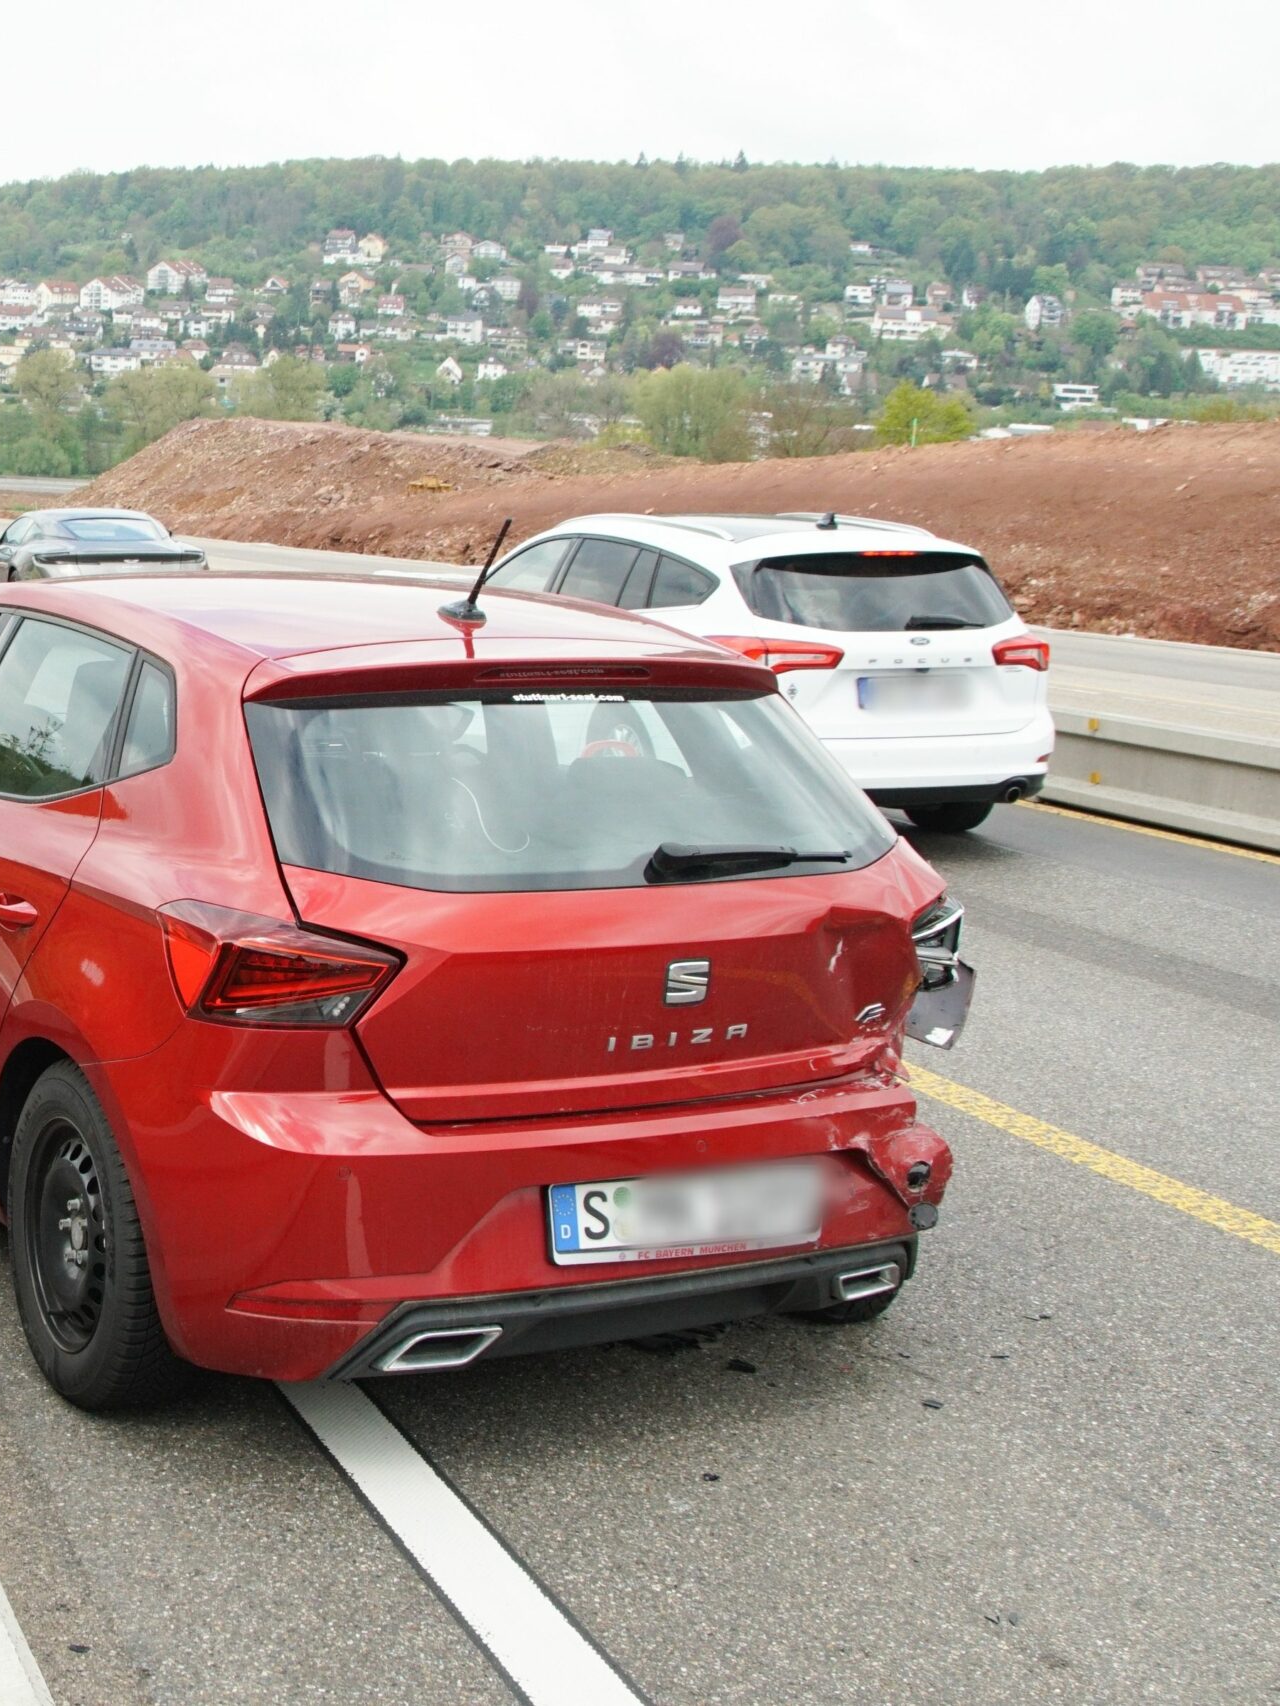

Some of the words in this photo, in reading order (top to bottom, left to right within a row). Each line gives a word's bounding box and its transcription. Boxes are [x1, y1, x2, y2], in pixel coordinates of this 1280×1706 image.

[868, 656, 973, 665] FOCUS
[607, 1023, 748, 1052] IBIZA
[560, 1224, 572, 1239] D
[583, 1190, 610, 1240] S
[637, 1249, 651, 1260] FC
[655, 1247, 694, 1258] BAYERN
